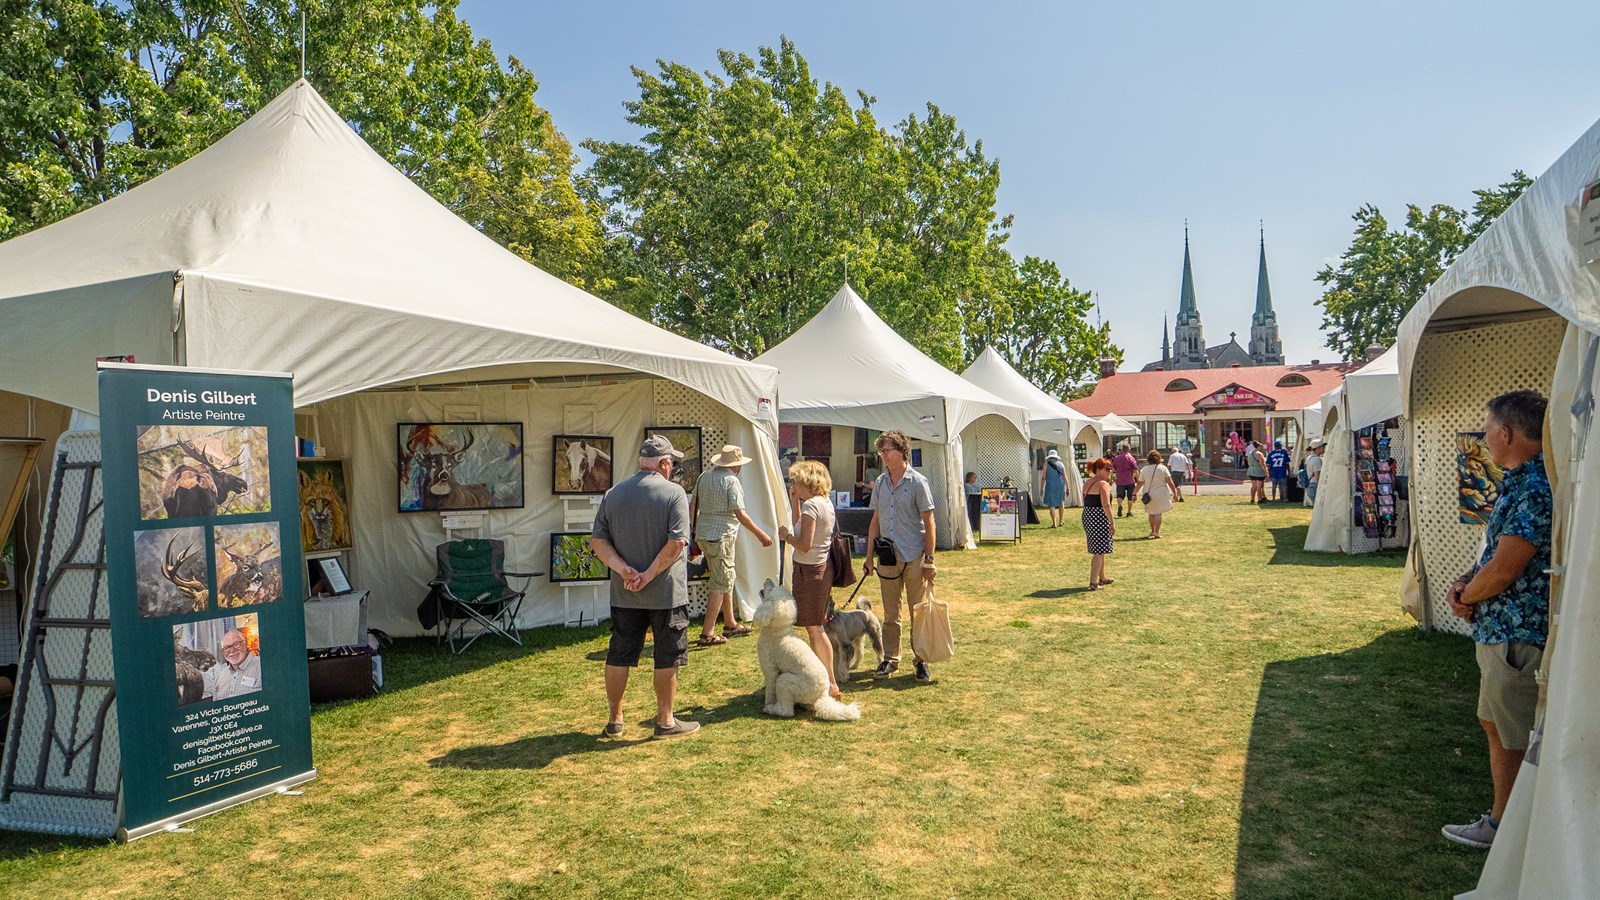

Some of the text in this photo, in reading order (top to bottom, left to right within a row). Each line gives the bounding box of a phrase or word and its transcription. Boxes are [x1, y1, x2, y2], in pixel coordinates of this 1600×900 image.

[147, 388, 257, 405] Denis Gilbert
[162, 409, 246, 421] Artiste Peintre
[1272, 457, 1284, 467] 27
[185, 699, 258, 723] 324 Victor Bourgeau
[243, 704, 270, 716] Canada
[182, 724, 263, 750] denisgilbert54@live.ca
[209, 725, 223, 735] J3X
[198, 735, 251, 755] Facebook.com
[173, 760, 196, 772] Denis
[248, 738, 273, 750] Peintre
[193, 758, 258, 787] 514-773-5686
